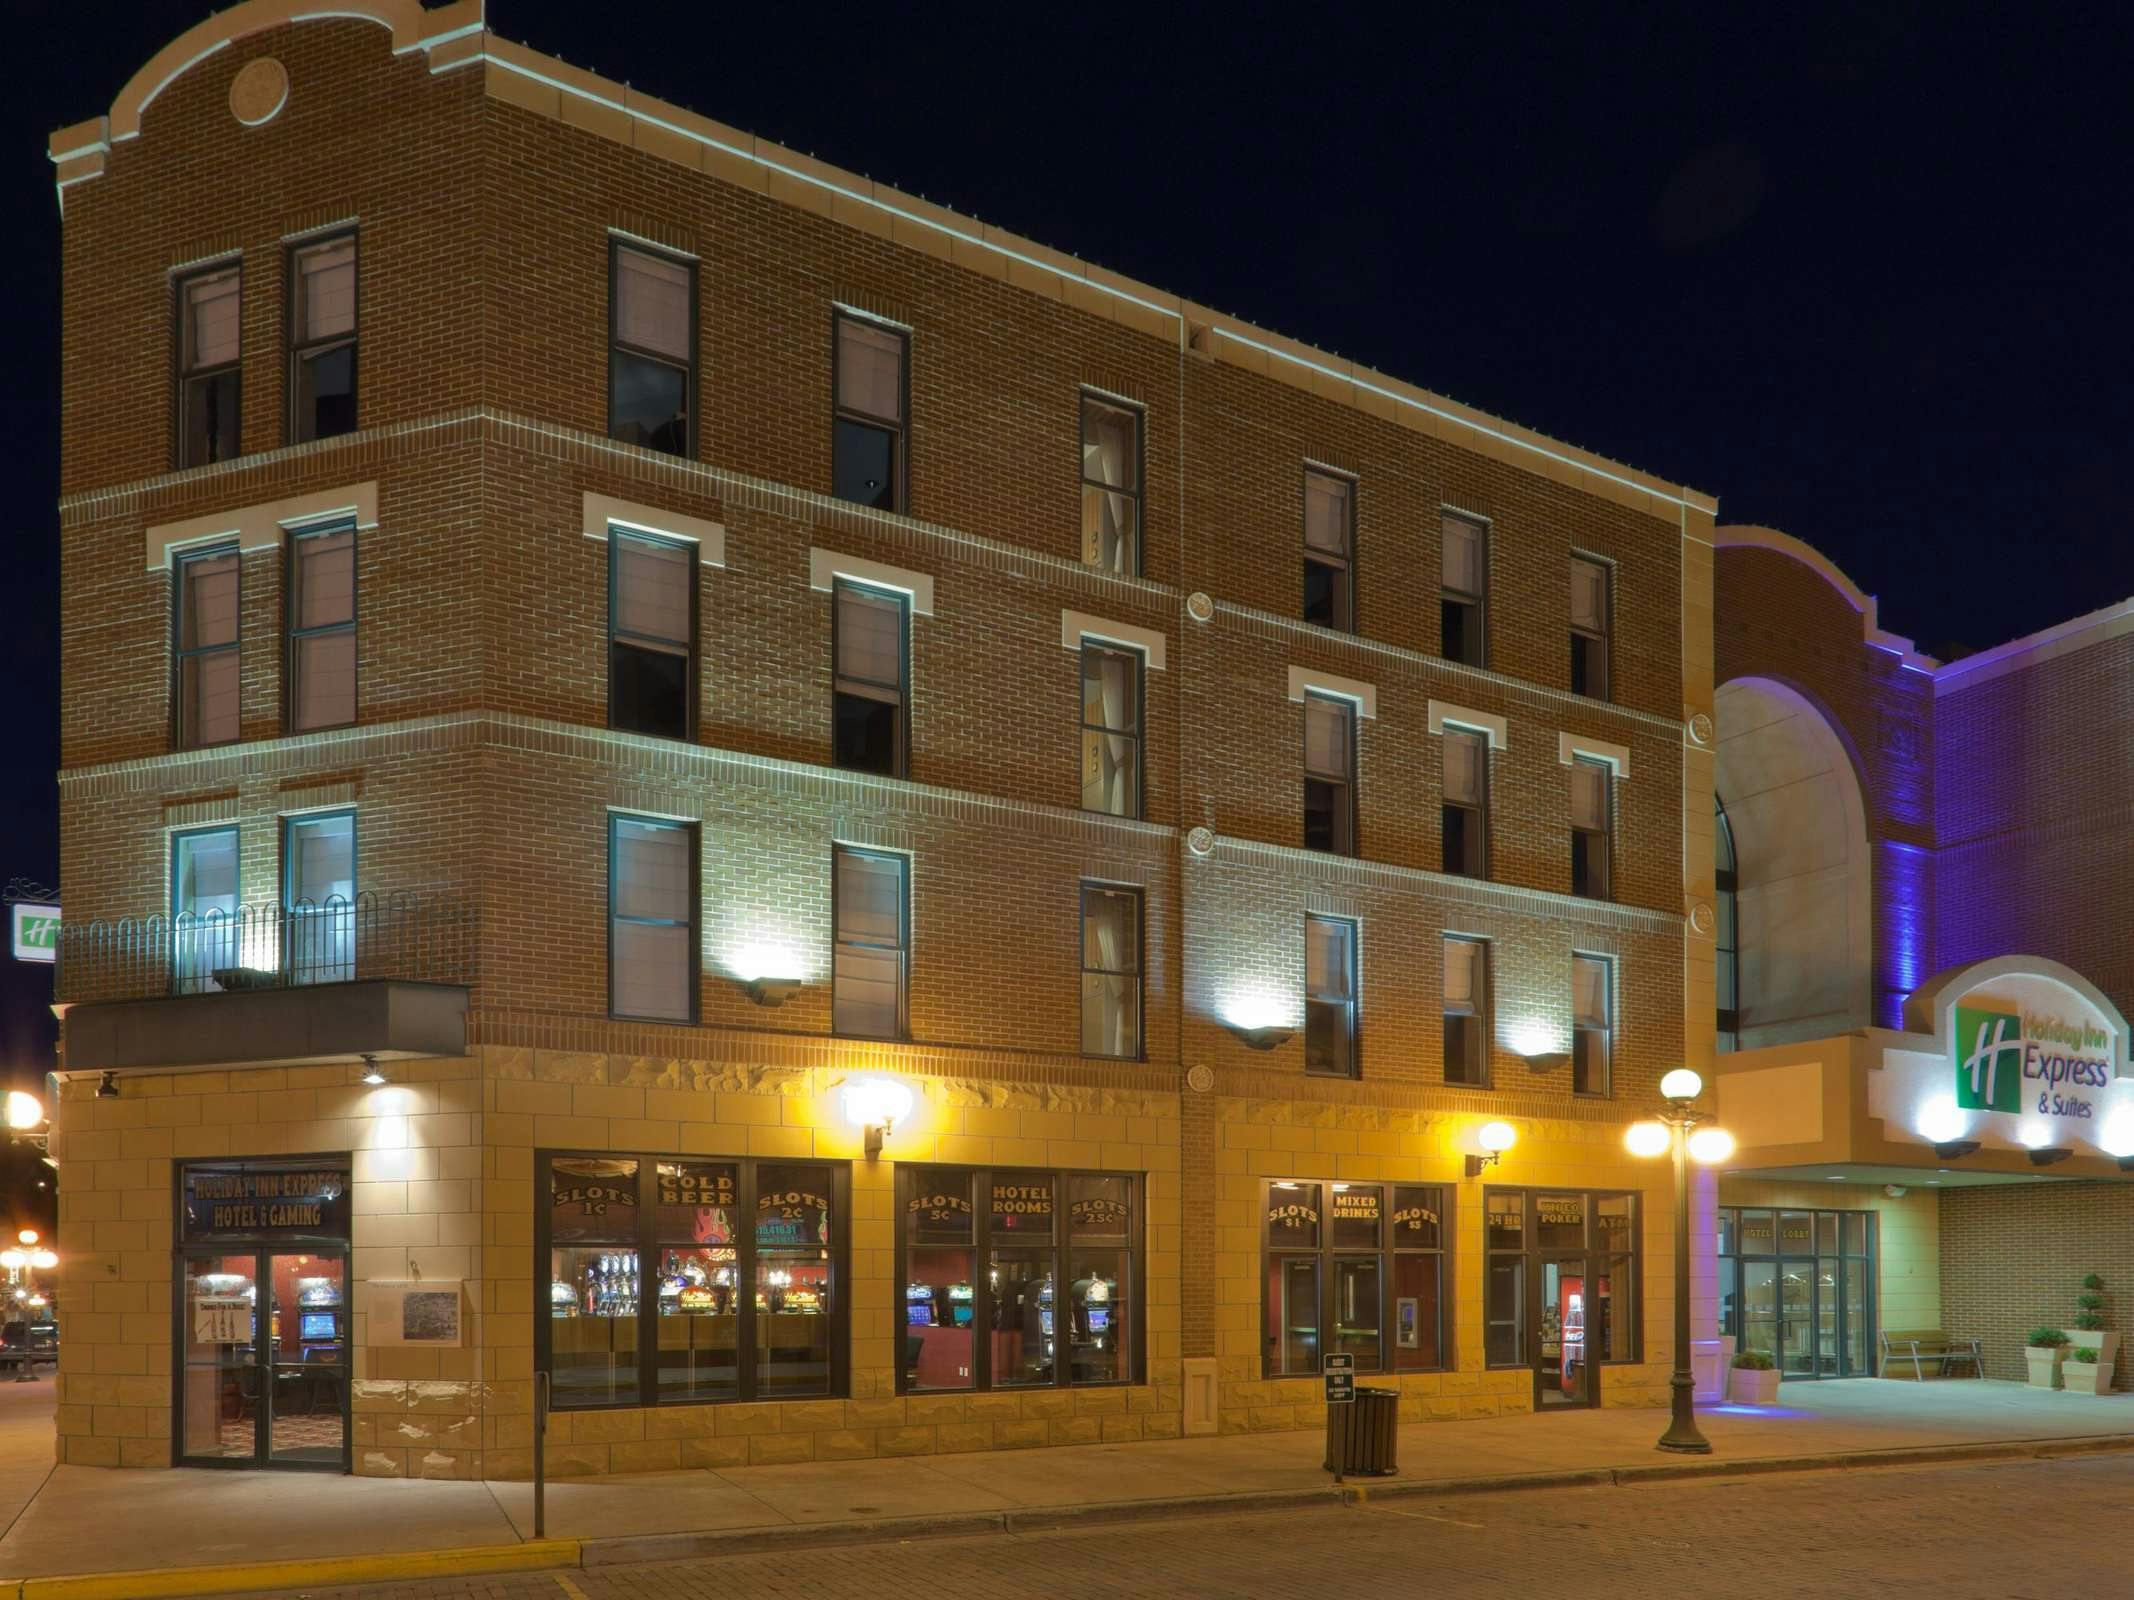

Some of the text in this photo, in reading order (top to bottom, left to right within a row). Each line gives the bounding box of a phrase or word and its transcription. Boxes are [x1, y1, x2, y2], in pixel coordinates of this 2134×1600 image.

[2022, 1008, 2108, 1052] Holiday Inn
[2023, 1044, 2108, 1091] Express
[2038, 1090, 2092, 1119] & Suites
[194, 1171, 343, 1200] HOLIDAY INN EXPRESS
[660, 1175, 733, 1190] COLD
[556, 1186, 636, 1206] SLOTS
[662, 1190, 733, 1205] BEER
[759, 1192, 828, 1210] SLOTS
[992, 1186, 1050, 1200] HOTEL
[1335, 1196, 1377, 1207] MIXED
[909, 1195, 972, 1213] SLOTS
[992, 1200, 1051, 1214] ROOMS
[1071, 1199, 1128, 1217] SLOTS
[1333, 1207, 1380, 1219] DRINKS
[213, 1205, 257, 1228] HOTEL
[270, 1204, 321, 1227] GAMING
[1269, 1204, 1318, 1223] SLOTS
[1393, 1207, 1439, 1225] SLOTS
[1541, 1214, 1581, 1225] POKER
